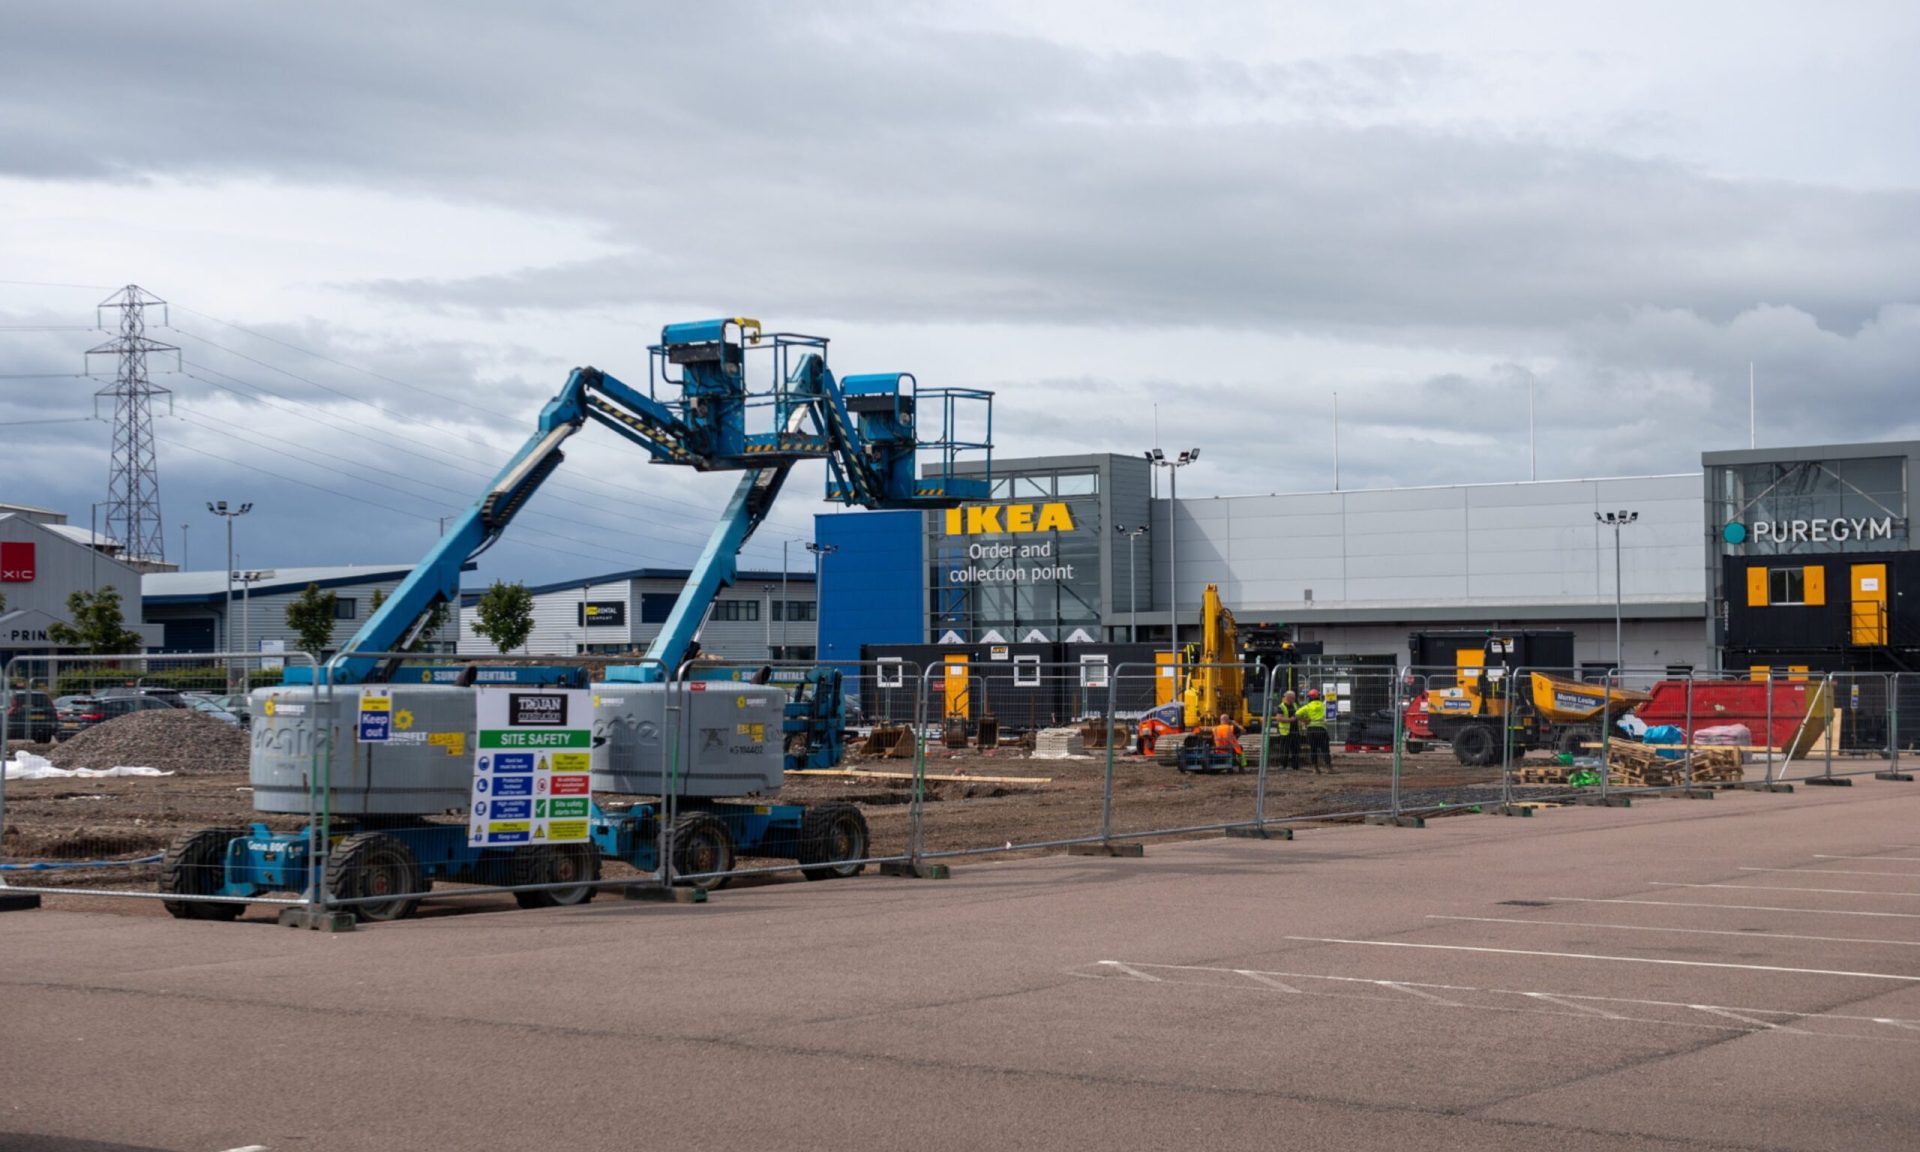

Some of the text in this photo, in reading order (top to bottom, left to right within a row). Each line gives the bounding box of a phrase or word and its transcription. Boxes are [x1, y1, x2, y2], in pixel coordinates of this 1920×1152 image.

[946, 503, 1075, 536] IKEA
[1753, 516, 1892, 544] PUREGYM
[969, 541, 1051, 560] Order and
[3, 570, 33, 579] XIC
[950, 564, 1074, 584] collection point
[11, 630, 48, 641] PRIN
[518, 697, 561, 711] TROJAN
[361, 713, 388, 726] Keep
[365, 727, 384, 738] out
[501, 733, 571, 745] SITE SAFETY
